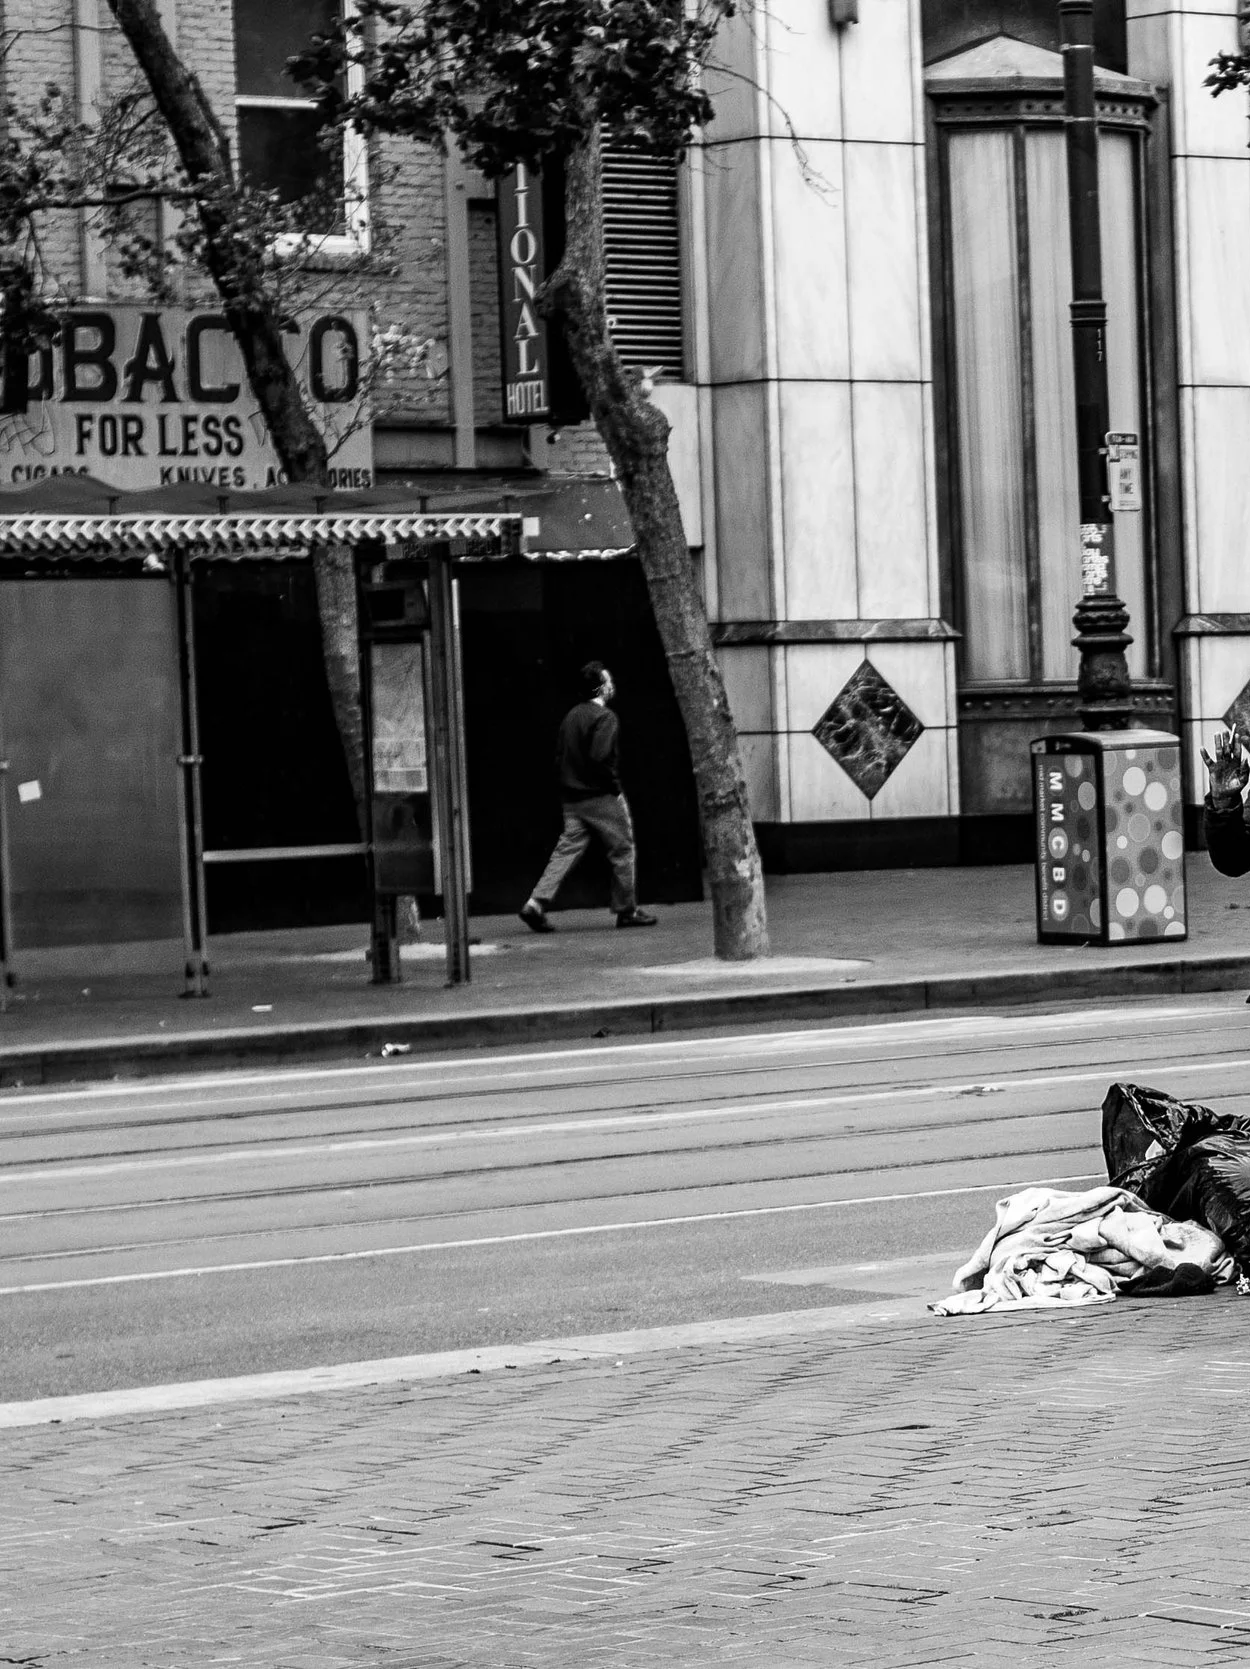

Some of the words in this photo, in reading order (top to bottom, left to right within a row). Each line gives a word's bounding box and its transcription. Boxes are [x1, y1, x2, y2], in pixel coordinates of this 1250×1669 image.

[506, 380, 549, 415] HOTEL
[74, 413, 148, 456] FOR
[156, 413, 244, 456] LESS
